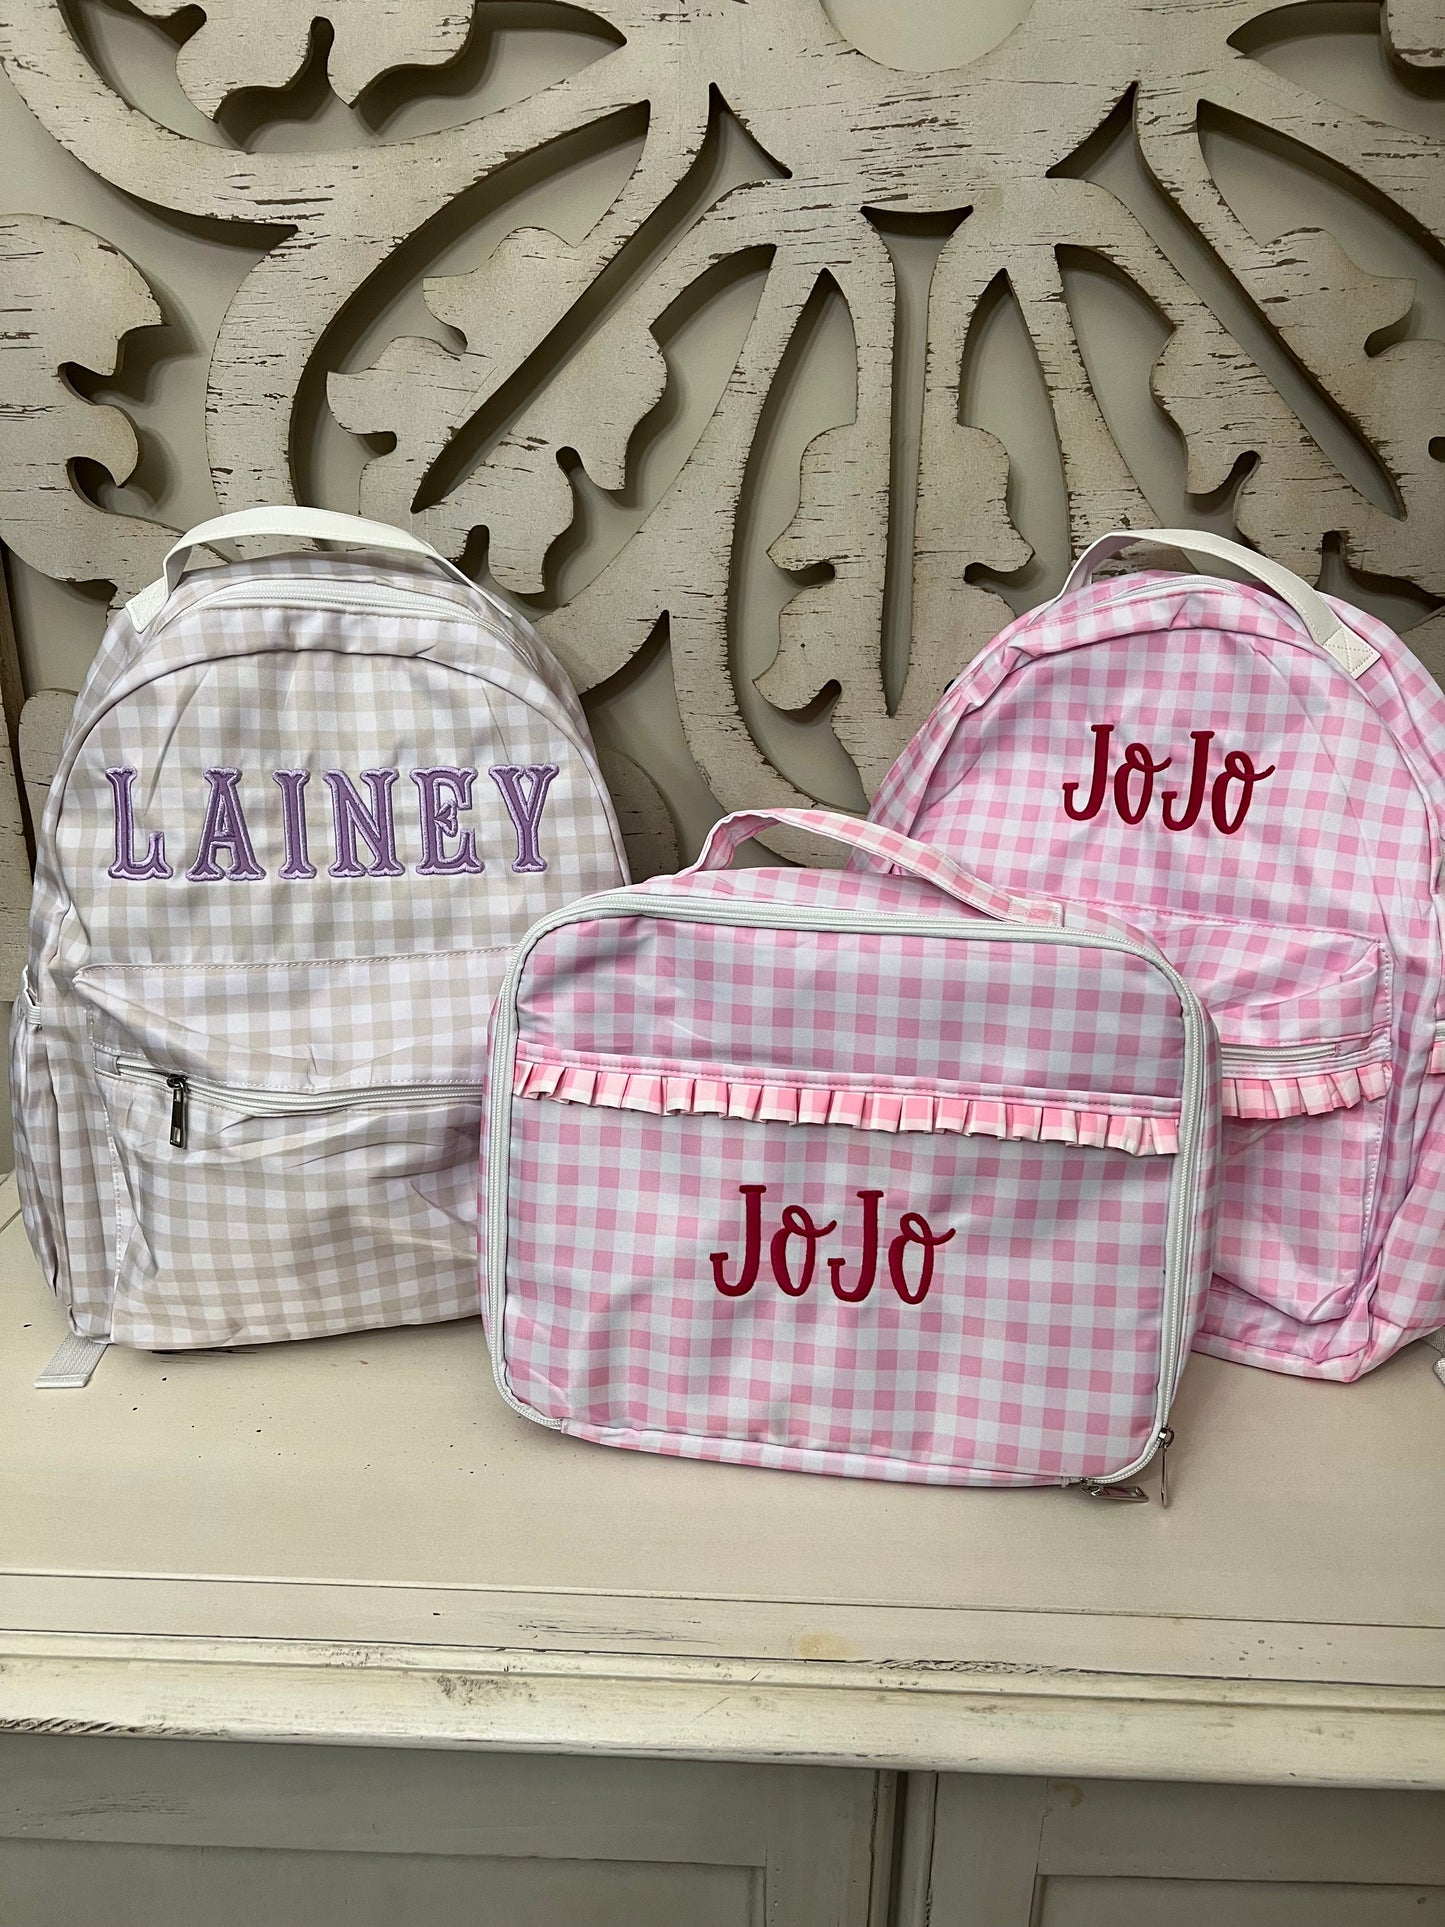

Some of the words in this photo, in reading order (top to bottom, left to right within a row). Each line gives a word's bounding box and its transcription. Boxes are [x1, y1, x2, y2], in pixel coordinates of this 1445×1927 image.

[105, 763, 560, 882] LAINEY
[1062, 723, 1276, 835] JoJo
[709, 1184, 956, 1305] JoJo
